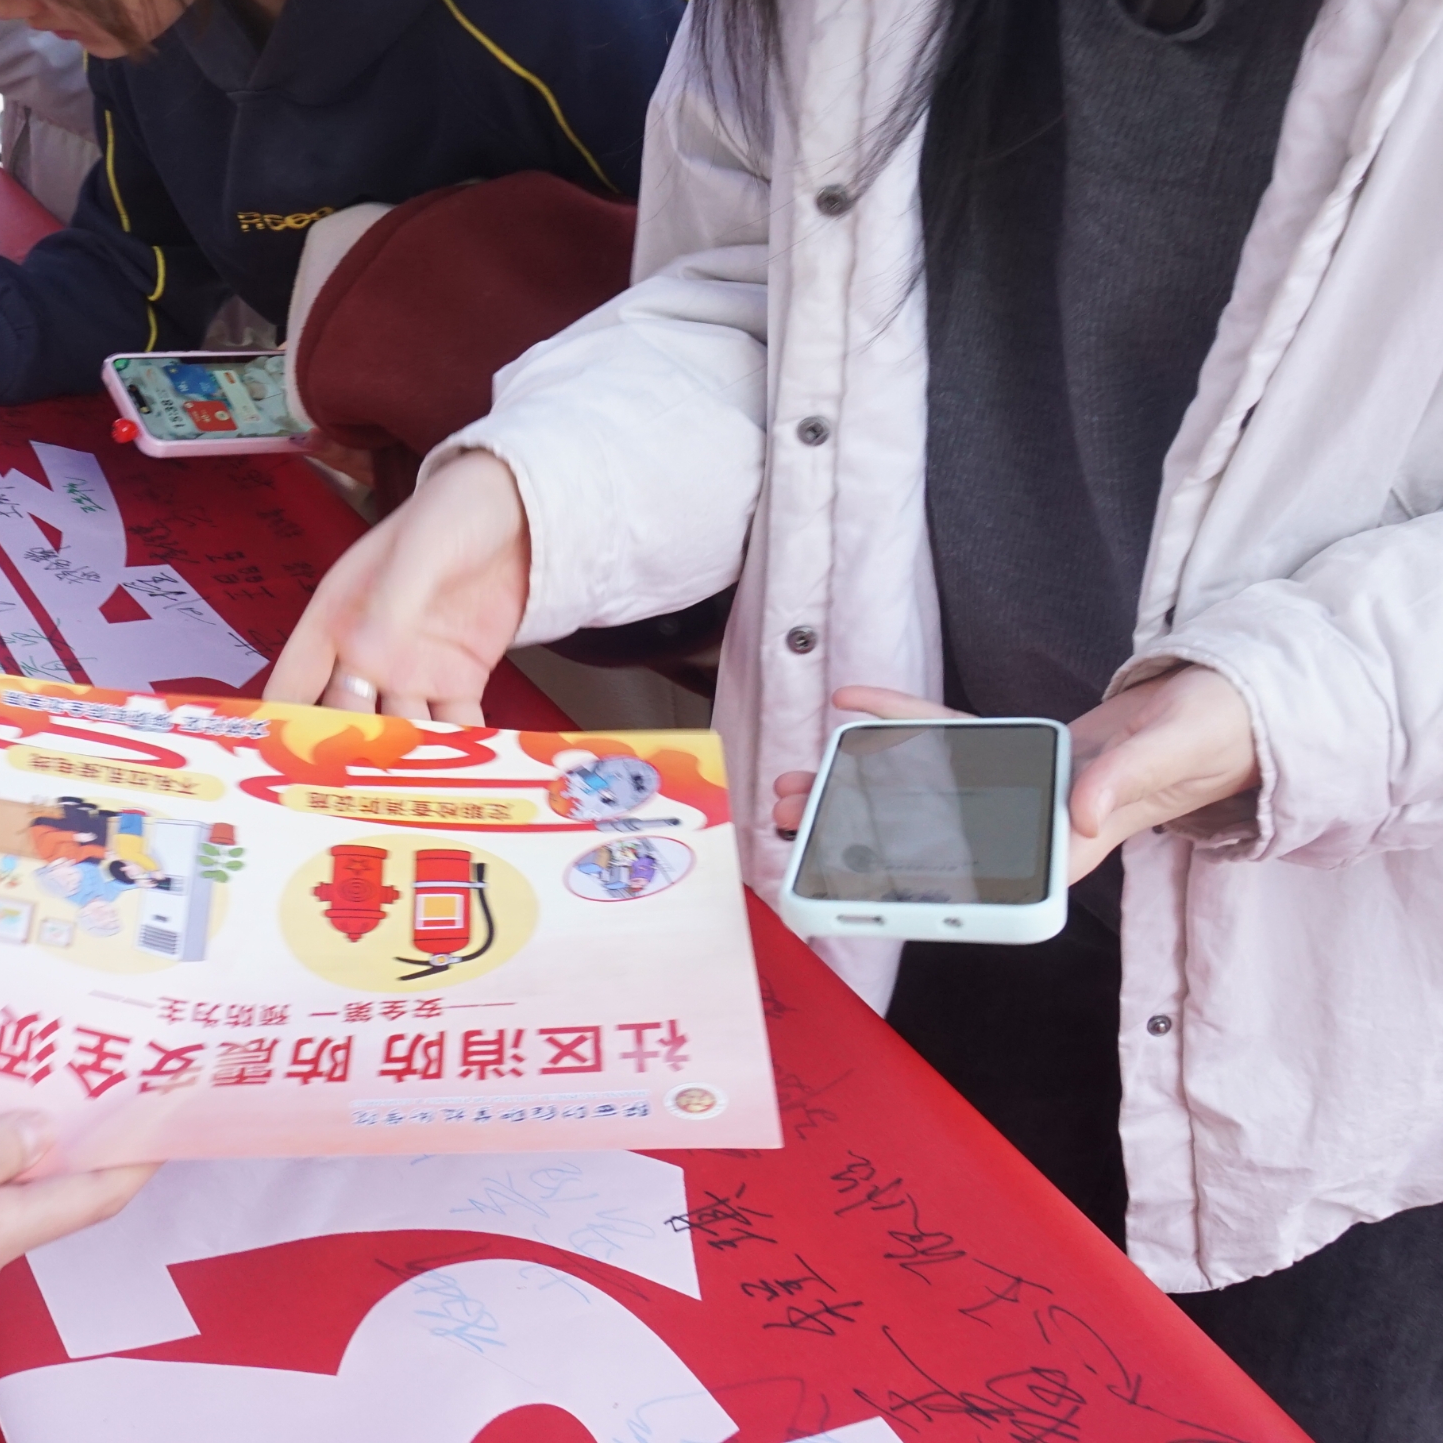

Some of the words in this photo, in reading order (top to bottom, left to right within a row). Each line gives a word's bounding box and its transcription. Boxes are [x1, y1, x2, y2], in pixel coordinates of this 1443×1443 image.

[26, 752, 199, 796] 不私拉乱接电线
[304, 791, 513, 822] 定期检查消防设施
[377, 1018, 690, 1085] 社区消防
